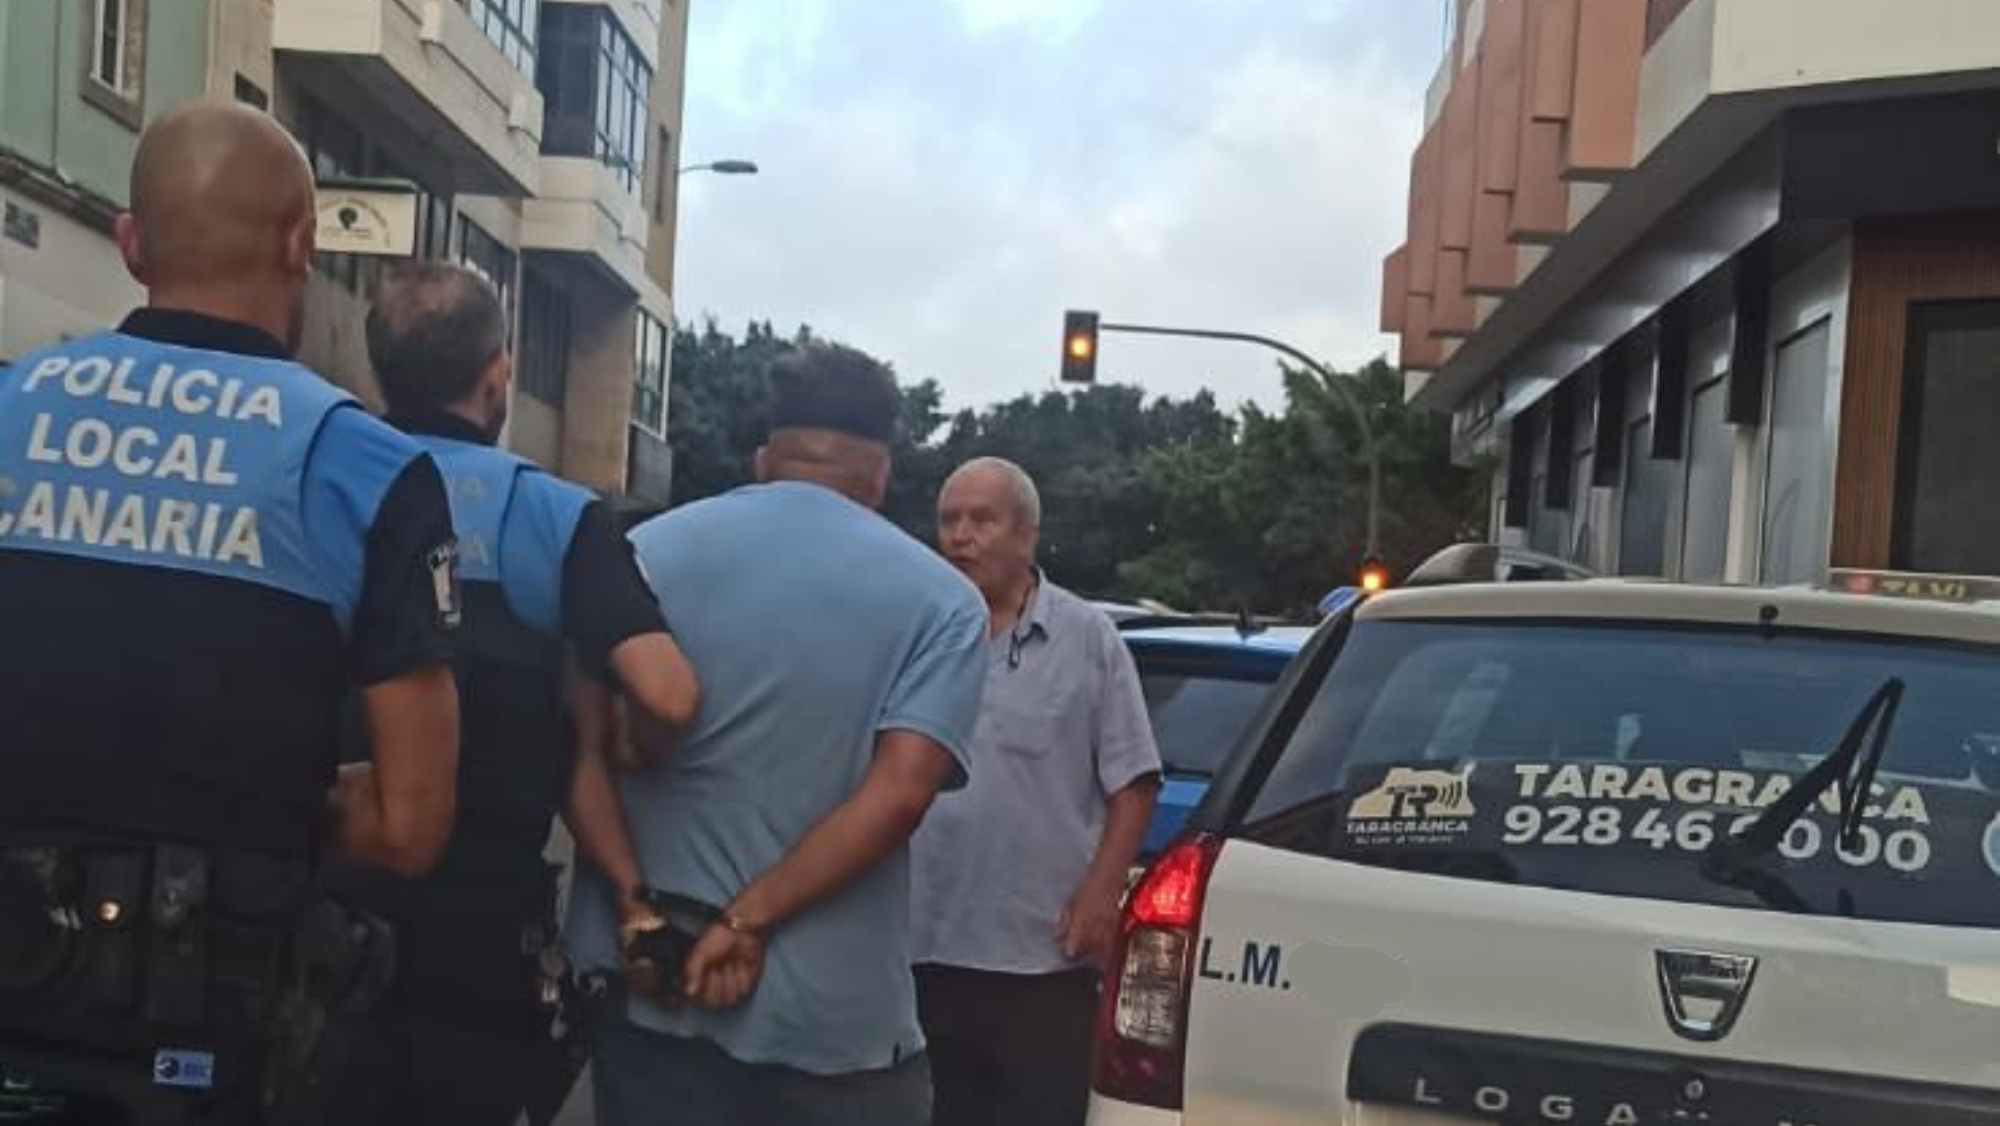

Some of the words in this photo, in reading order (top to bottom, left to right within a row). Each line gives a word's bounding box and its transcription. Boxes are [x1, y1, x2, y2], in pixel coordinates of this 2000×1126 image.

[22, 356, 281, 427] POLICIA
[27, 413, 238, 485] LOCAL
[1503, 804, 1623, 845] 928
[1631, 808, 1714, 851] 46
[1728, 814, 1822, 858] 0
[1834, 825, 1931, 871] 00
[1199, 937, 1291, 990] L.M.
[1414, 1078, 1709, 1126] LOGA
